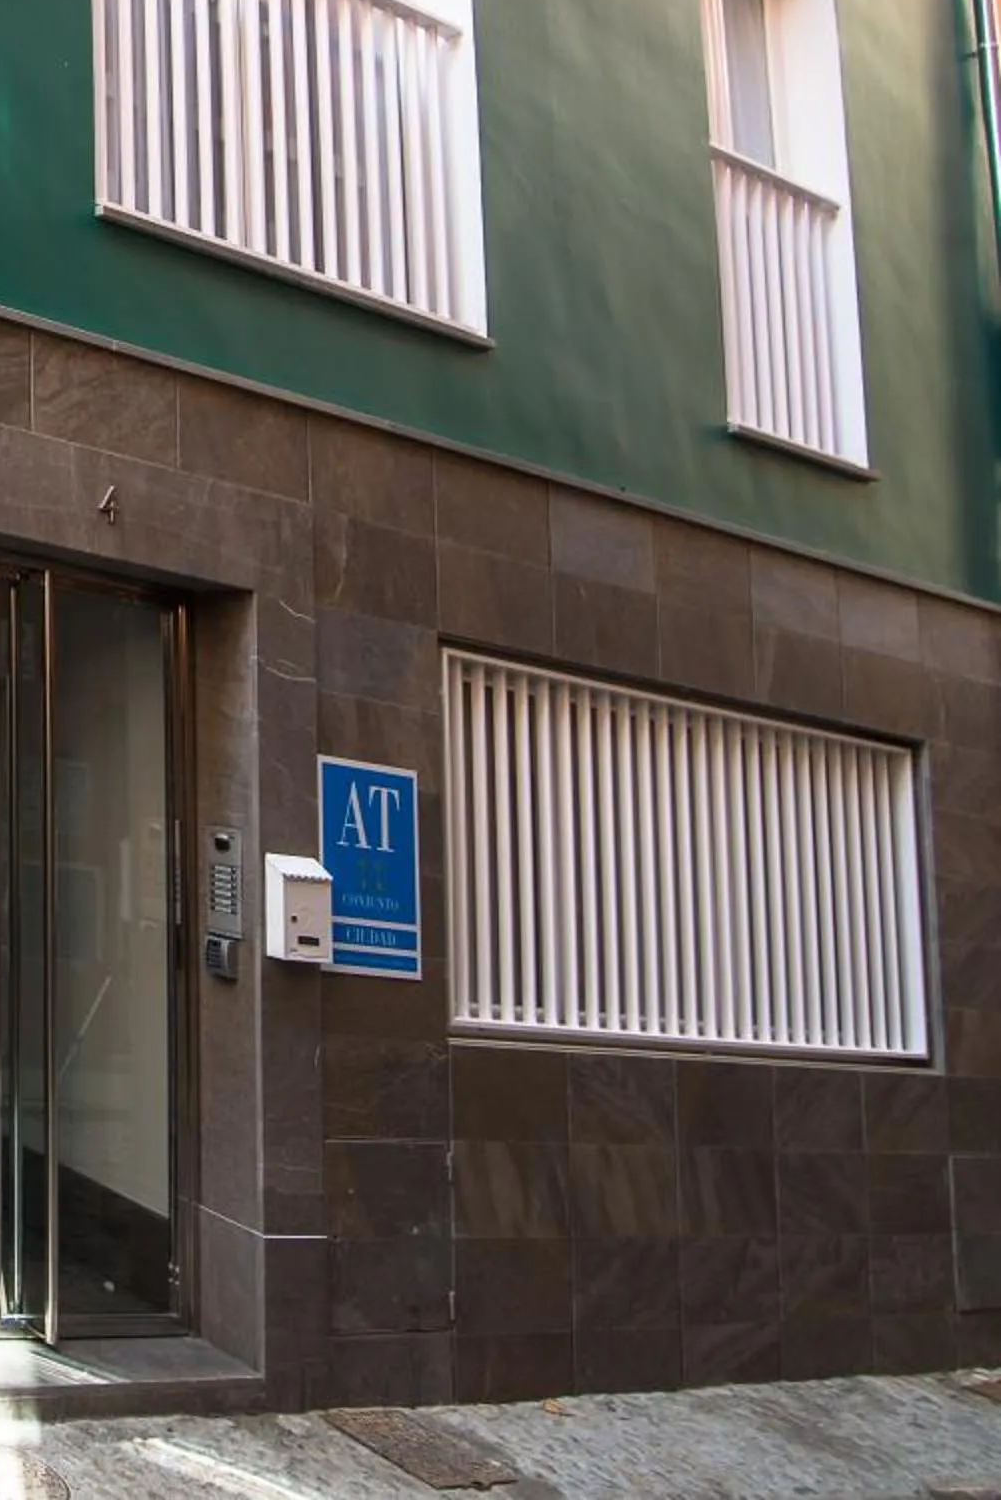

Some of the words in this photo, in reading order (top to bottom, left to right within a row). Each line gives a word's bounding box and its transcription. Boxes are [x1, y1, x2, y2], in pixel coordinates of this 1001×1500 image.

[99, 485, 119, 523] 4
[336, 780, 401, 853] AT
[346, 926, 397, 947] CIUDAD
